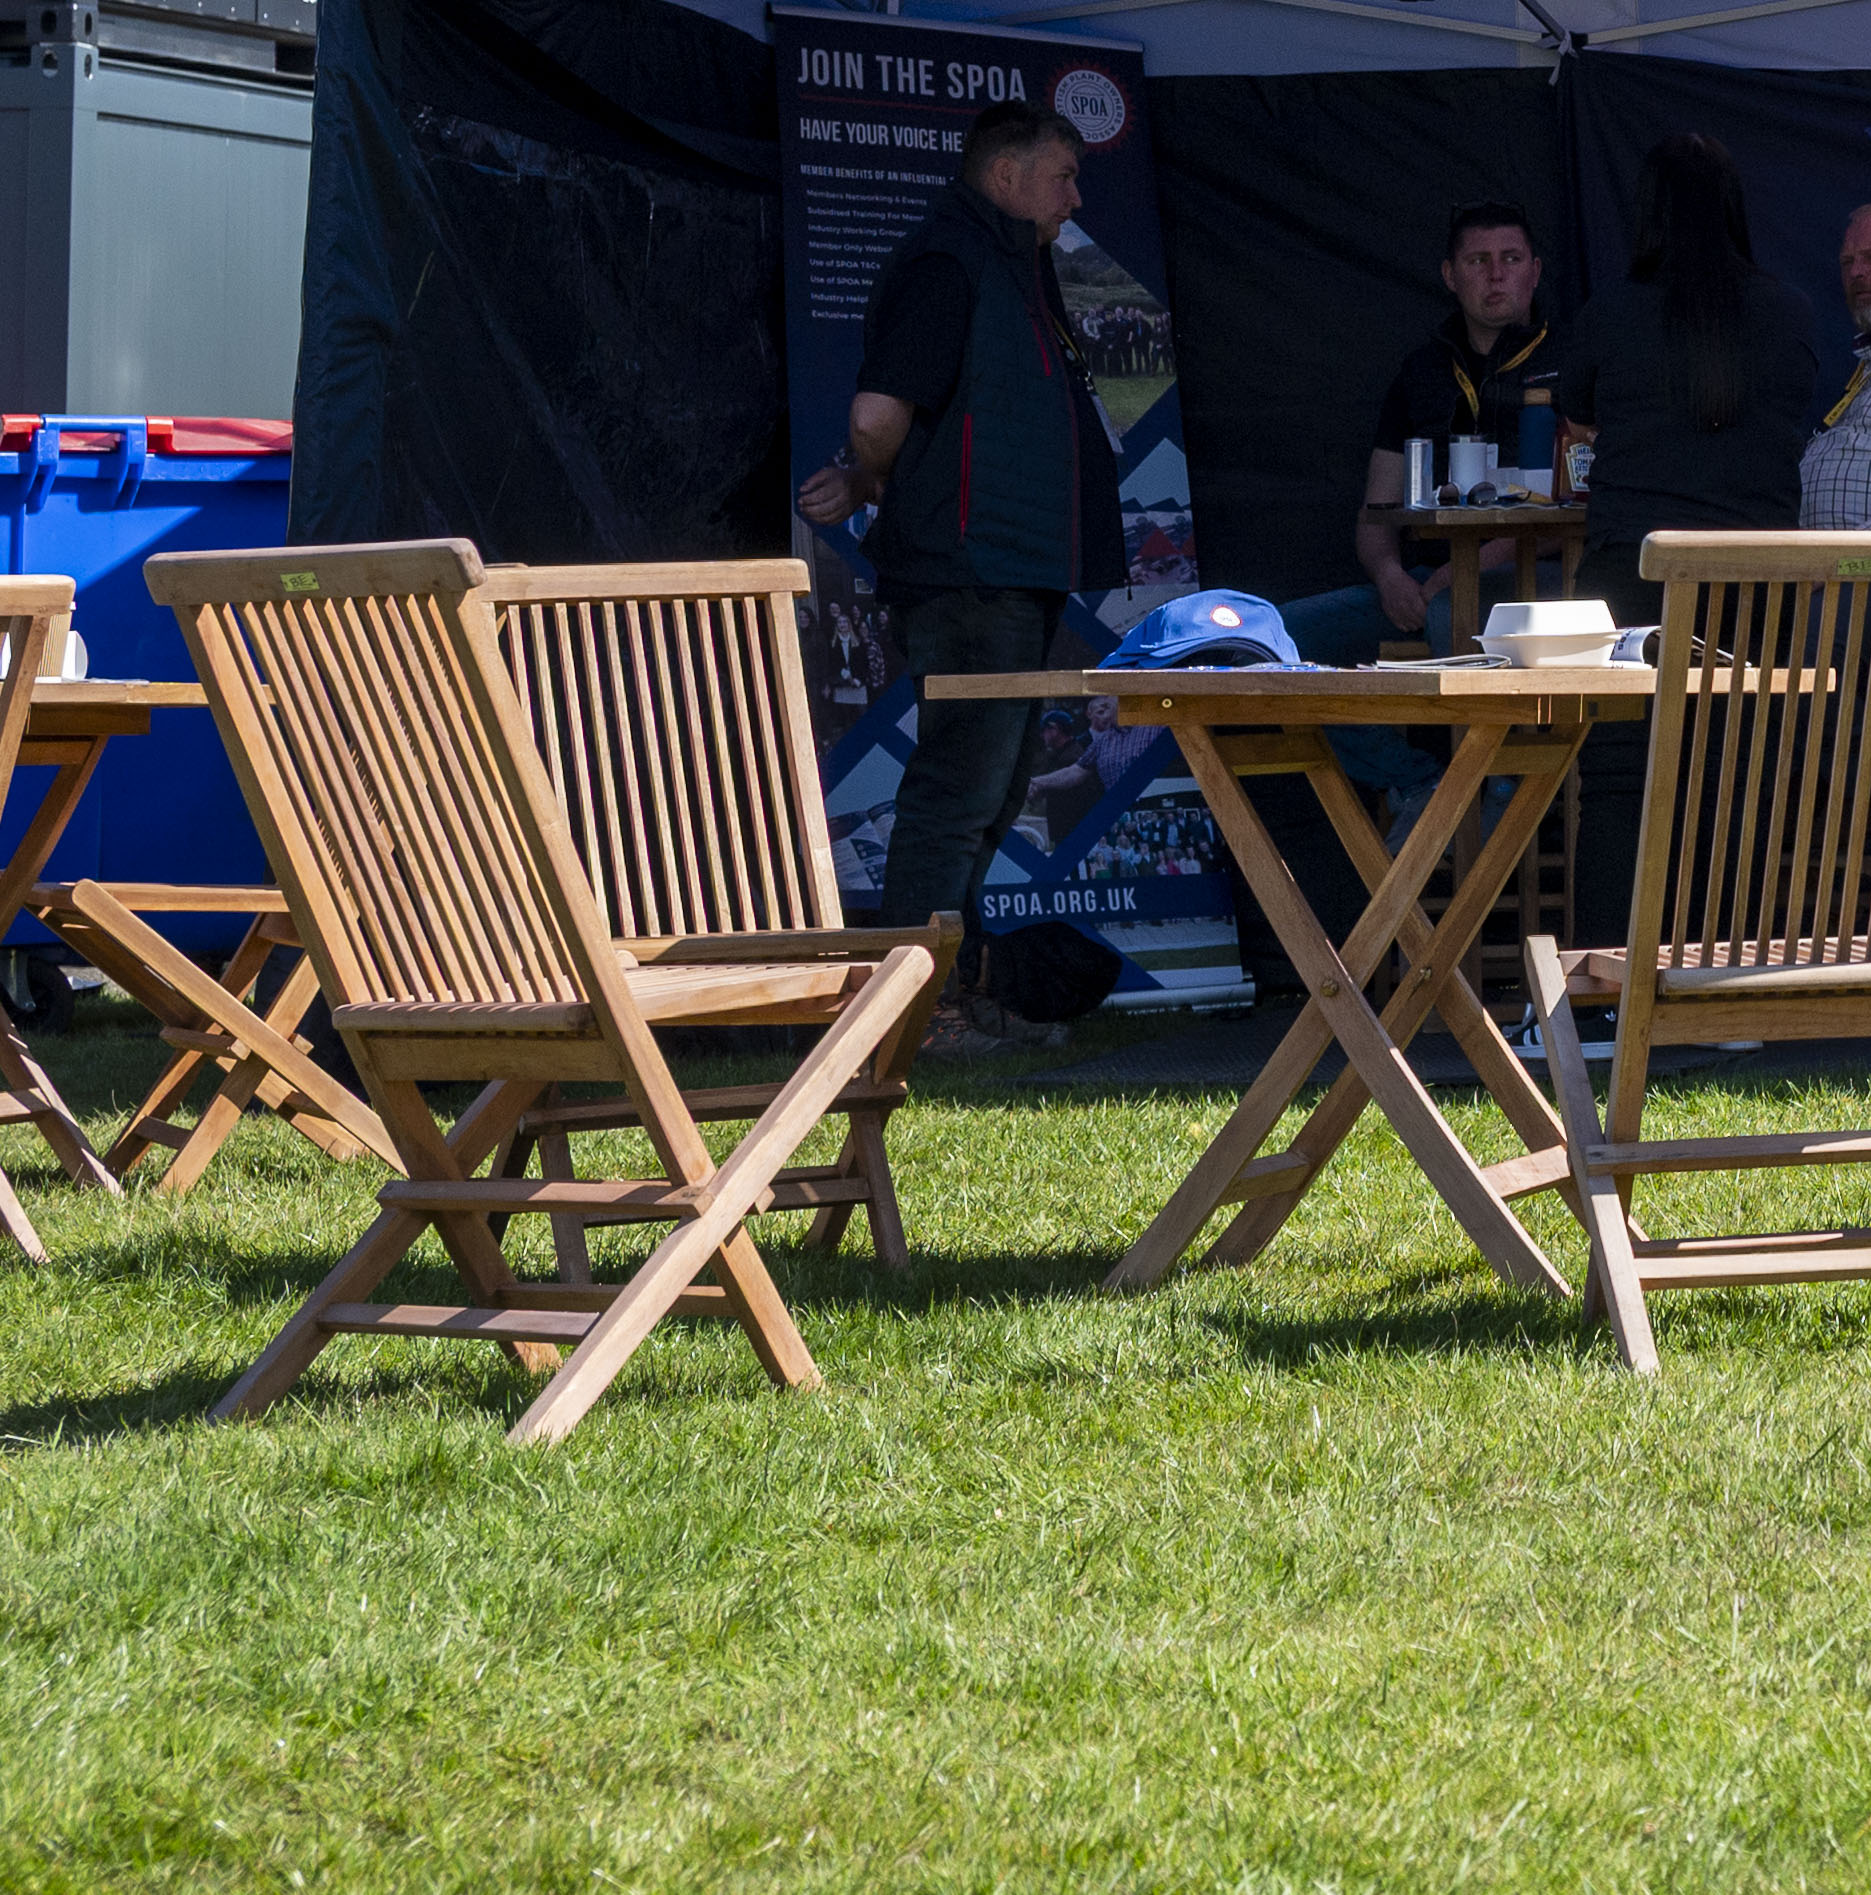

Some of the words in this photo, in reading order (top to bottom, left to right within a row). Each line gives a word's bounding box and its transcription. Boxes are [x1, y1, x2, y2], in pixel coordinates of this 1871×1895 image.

[798, 47, 864, 91] JOIN
[875, 54, 935, 96] THE
[946, 61, 1028, 103] SPOA
[1071, 95, 1109, 117] SPOA
[799, 116, 841, 142] HAVE
[845, 122, 889, 146] YOUR
[893, 126, 938, 151] VOICE
[942, 131, 966, 153] HE
[800, 163, 834, 177] MEMBER
[835, 167, 873, 181] BENEFITS
[875, 169, 885, 181] OF
[887, 170, 899, 182] AN
[900, 171, 947, 186] INFLUENTIAL
[806, 189, 844, 200] Members
[845, 193, 893, 204] Networking
[852, 209, 886, 220] Training
[808, 224, 841, 235] Industry
[842, 226, 877, 237] Working
[808, 241, 841, 251] Member
[843, 243, 863, 253] Only
[809, 259, 824, 268] Use
[836, 260, 859, 269] SPOA
[810, 276, 825, 284] Use
[827, 276, 835, 284] of
[837, 277, 860, 286] SPOA
[811, 293, 844, 303] Industry
[811, 309, 848, 319] Exclusive
[983, 887, 1137, 918] SPOA.ORG.UK
